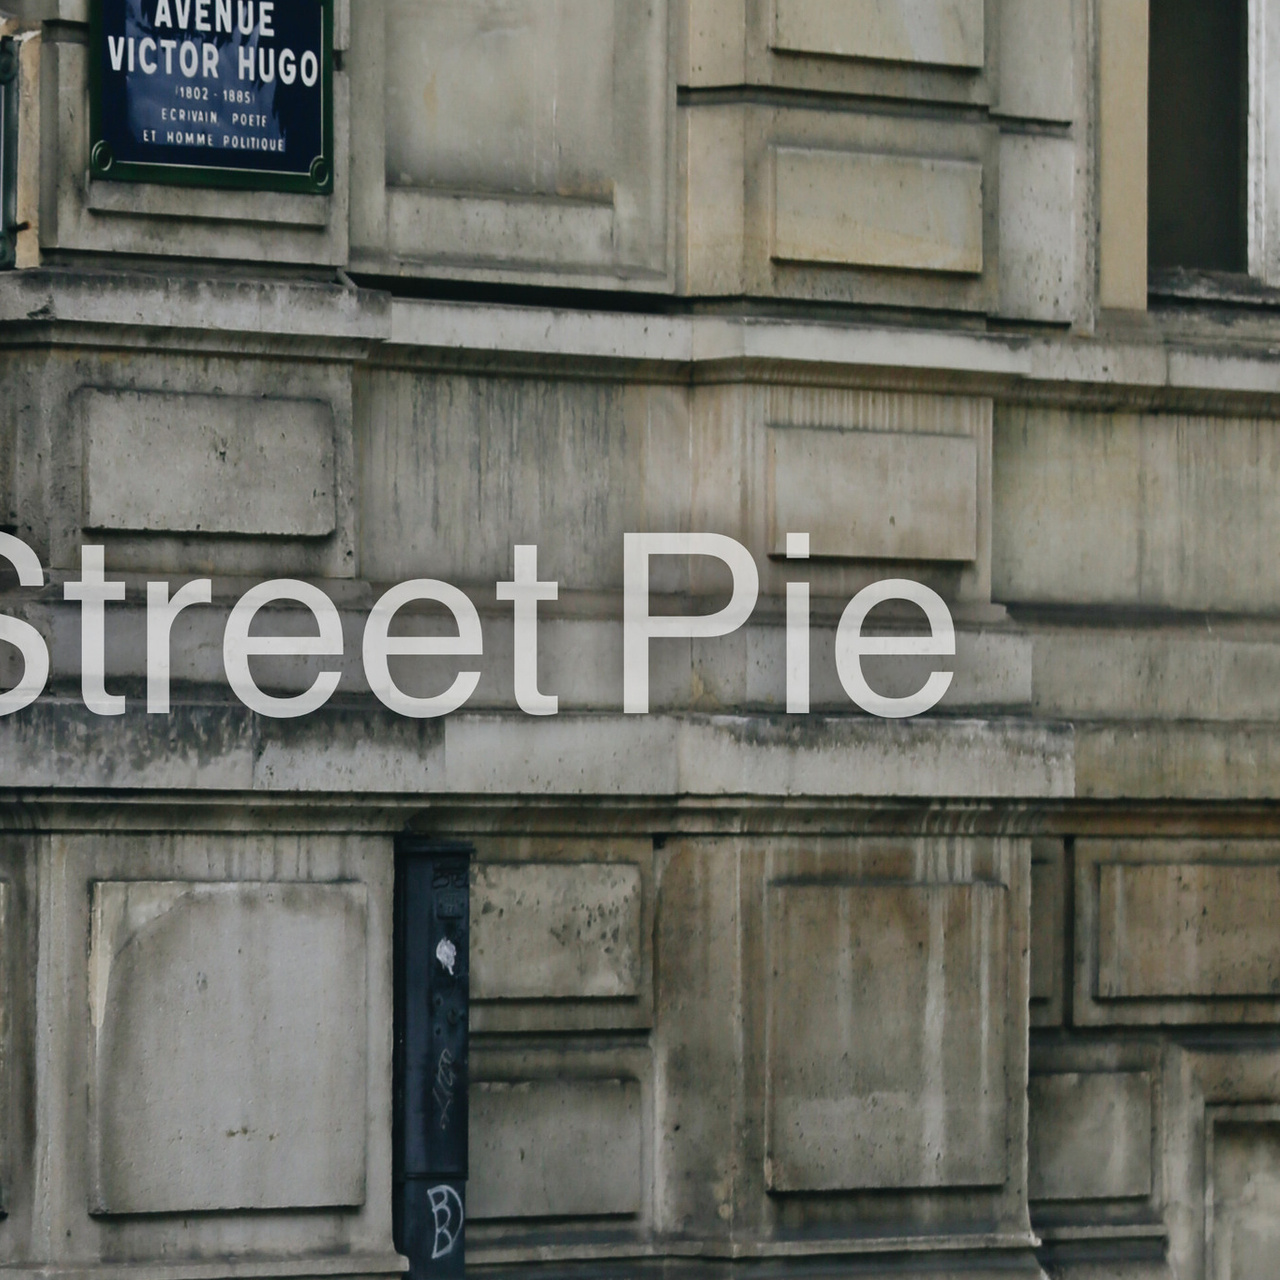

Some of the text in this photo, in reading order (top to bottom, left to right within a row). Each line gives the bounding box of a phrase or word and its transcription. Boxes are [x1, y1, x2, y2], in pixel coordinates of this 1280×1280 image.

[107, 35, 319, 88] VICTOR HUGO
[232, 112, 268, 128] POETE
[143, 129, 286, 152] ET HOMME POLITIQUE
